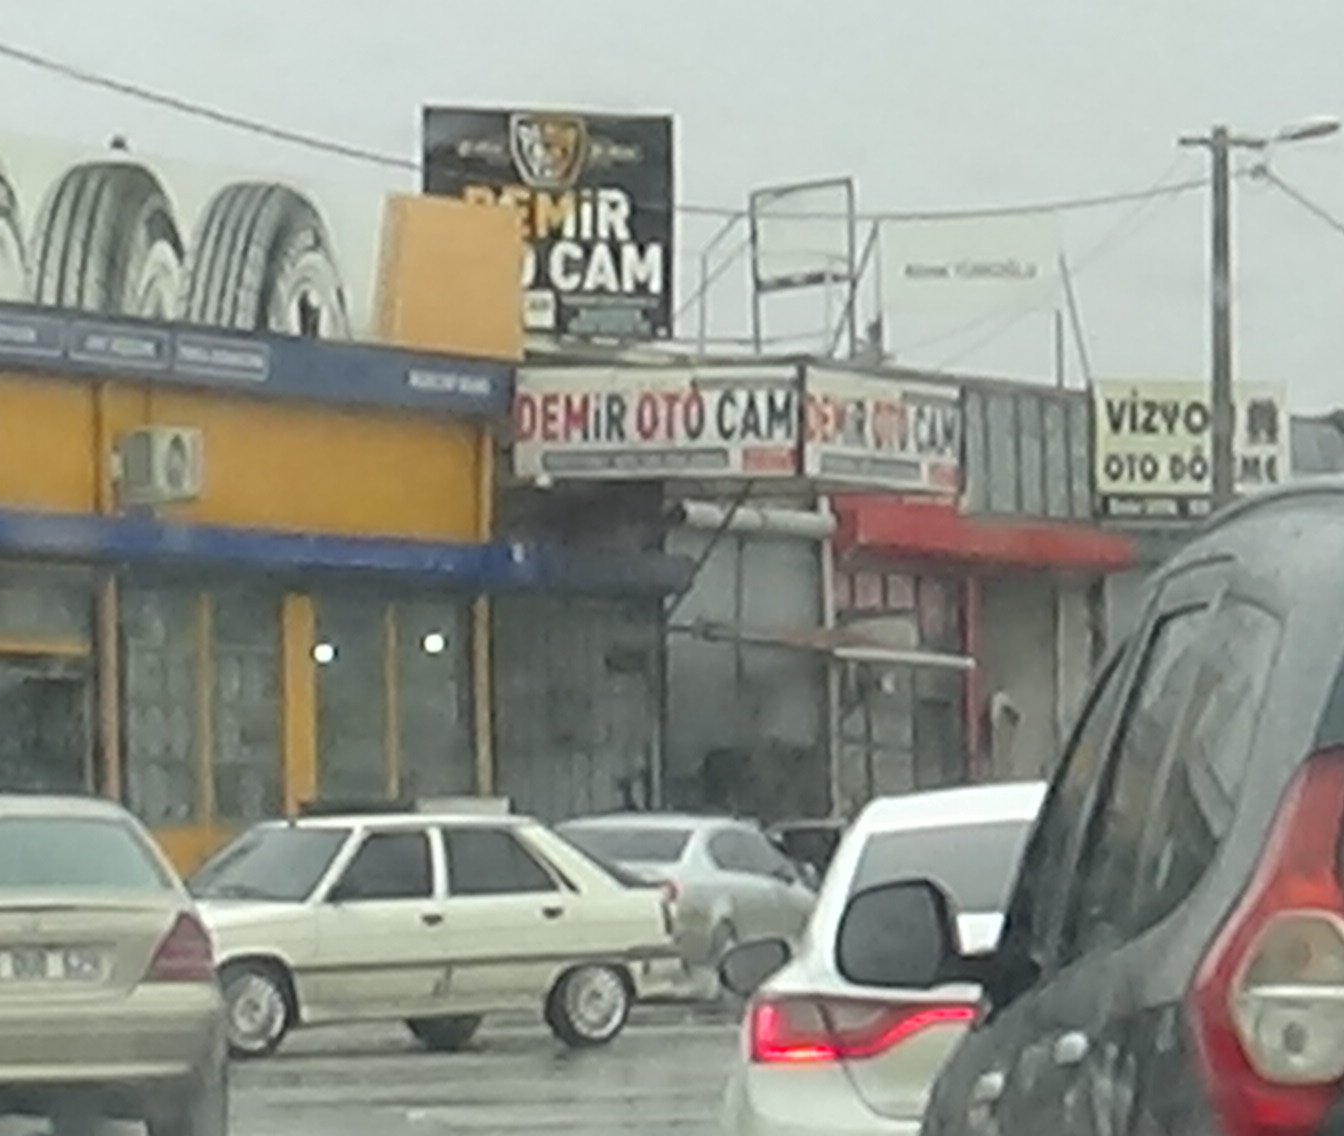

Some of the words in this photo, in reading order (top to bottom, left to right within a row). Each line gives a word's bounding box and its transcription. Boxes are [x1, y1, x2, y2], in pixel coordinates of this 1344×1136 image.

[548, 241, 663, 294] CAM
[637, 389, 705, 442] OTO
[716, 388, 793, 442] CAM
